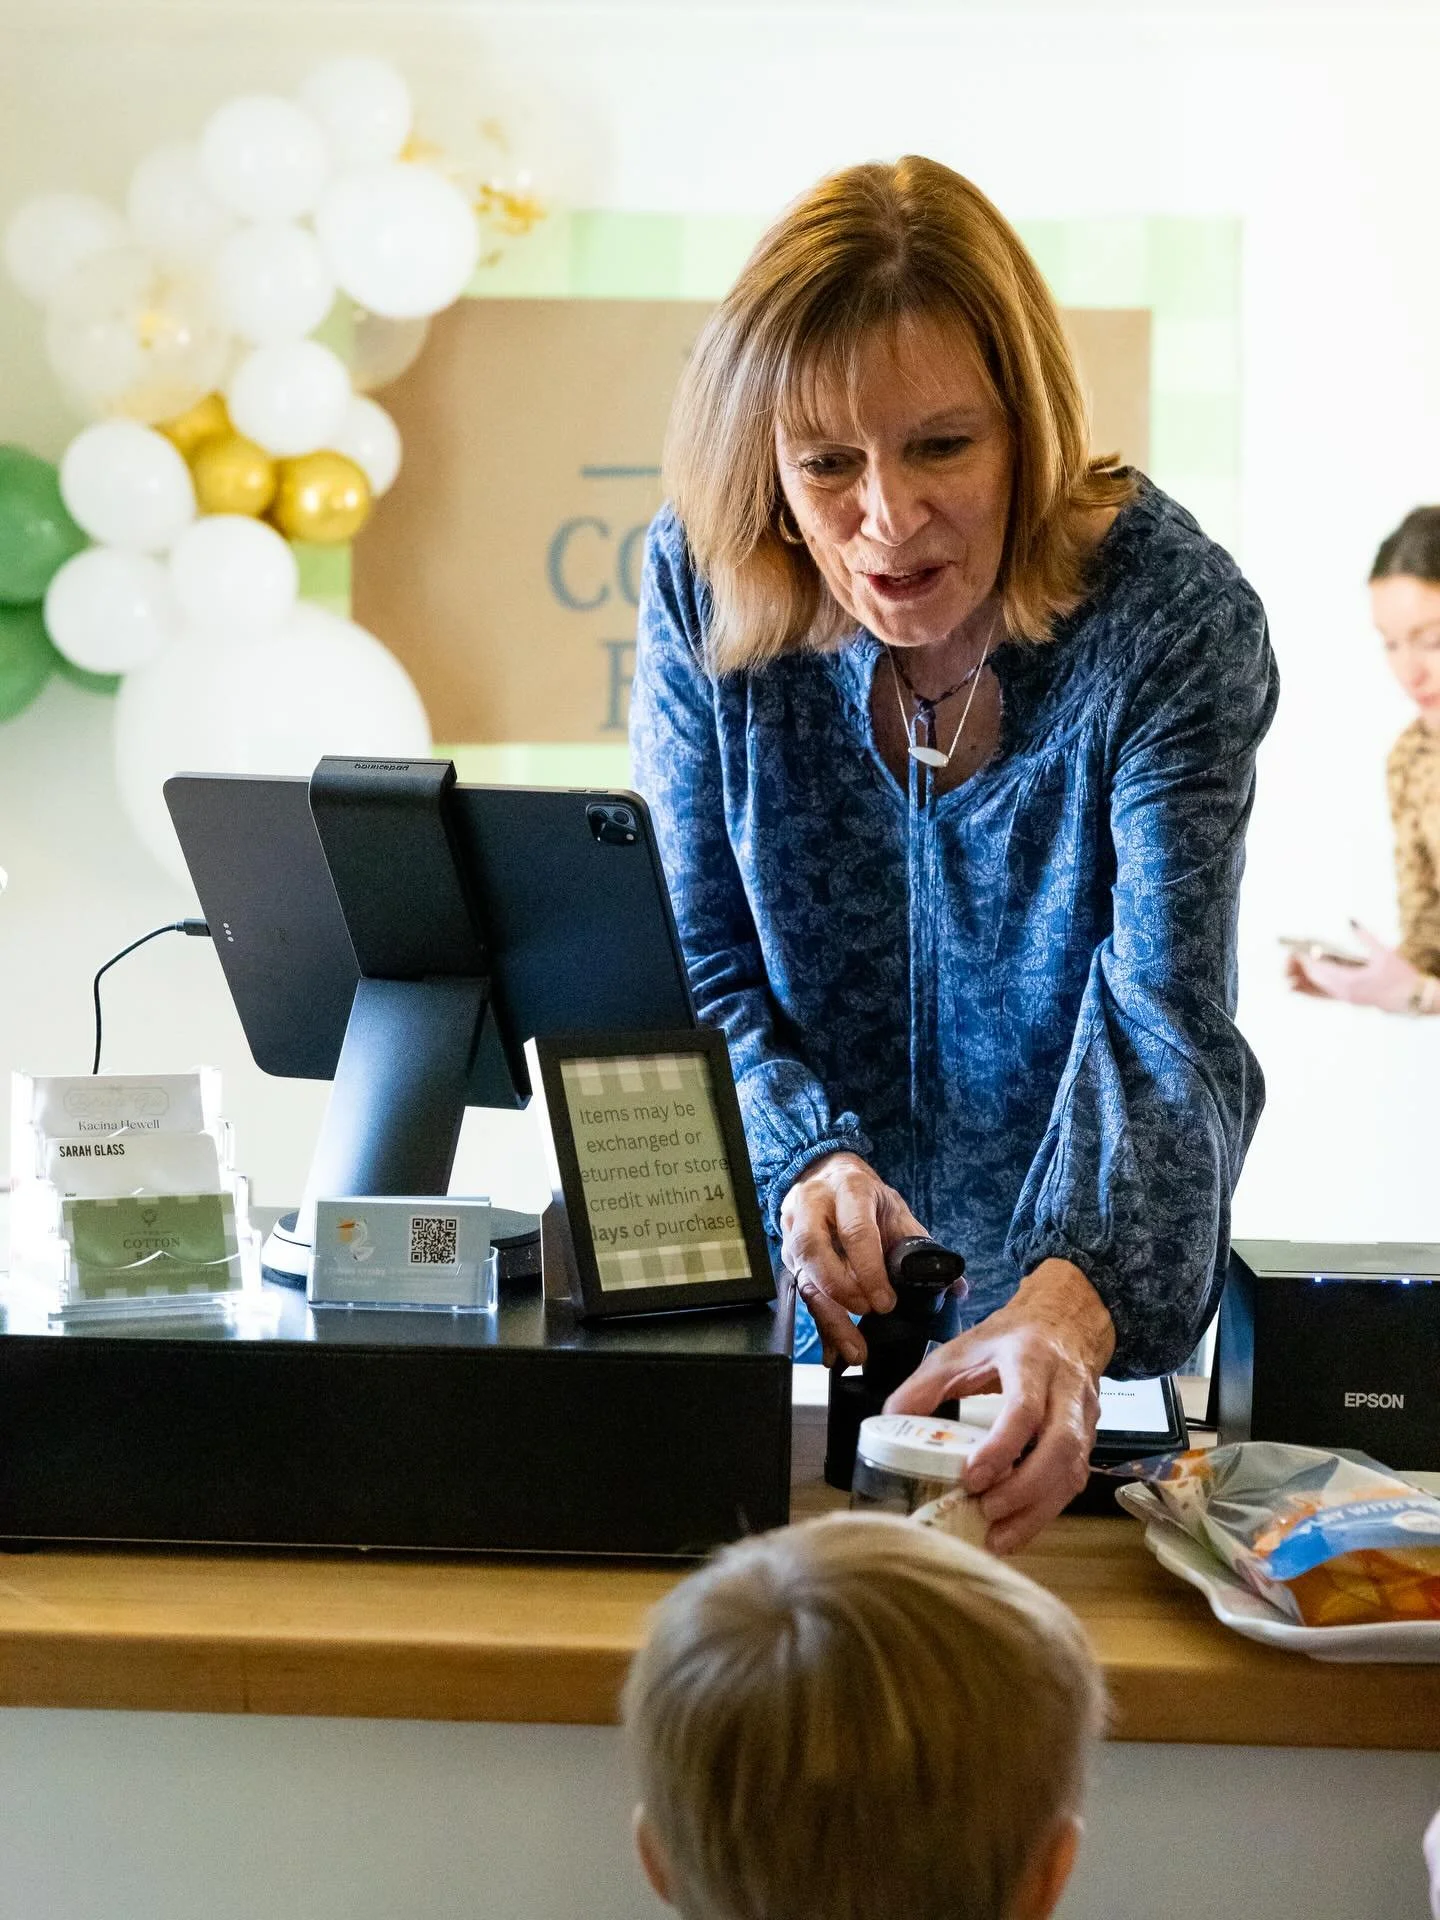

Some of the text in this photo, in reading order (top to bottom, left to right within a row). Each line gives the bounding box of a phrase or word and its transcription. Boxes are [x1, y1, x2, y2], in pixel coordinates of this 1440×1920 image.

[579, 1101, 696, 1125] Items may be
[59, 1143, 125, 1157] SARAH GLASS
[586, 1130, 702, 1153] exchanged or
[581, 1157, 729, 1183] eturned for store
[590, 1184, 725, 1212] credit within 14
[633, 1219, 651, 1238] of
[123, 1236, 180, 1250] COTTON
[1344, 1392, 1404, 1409] EPSON
